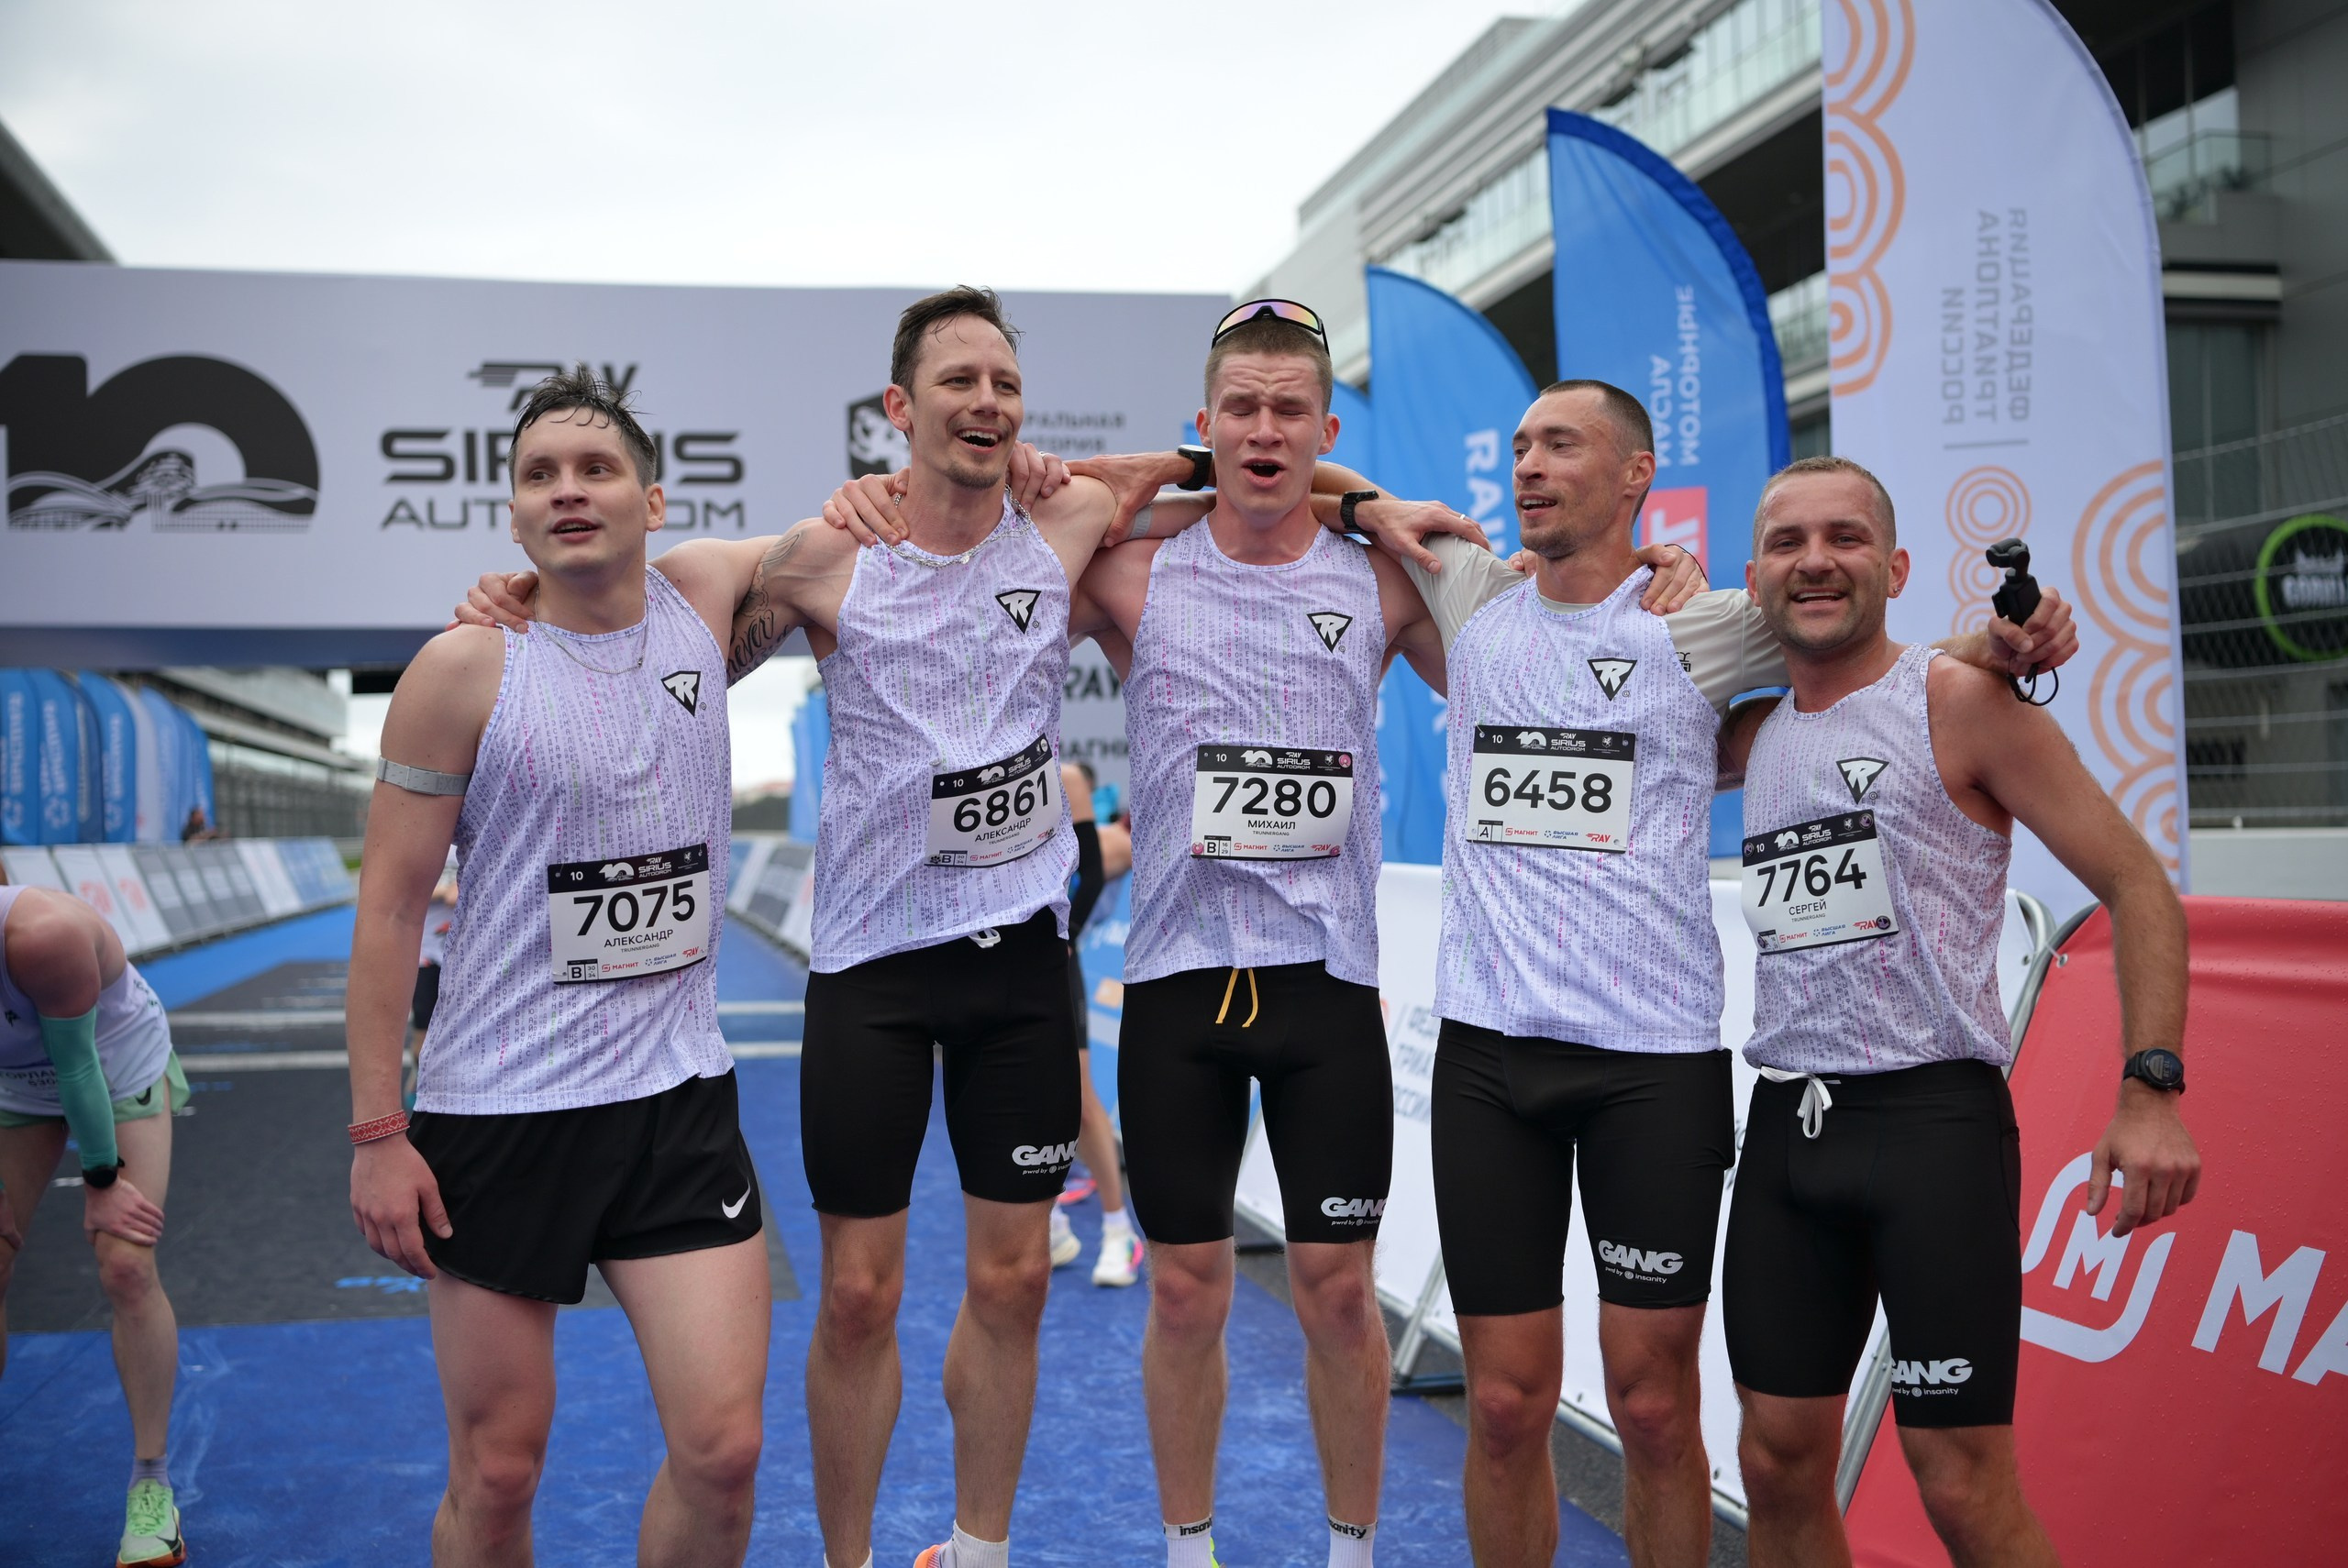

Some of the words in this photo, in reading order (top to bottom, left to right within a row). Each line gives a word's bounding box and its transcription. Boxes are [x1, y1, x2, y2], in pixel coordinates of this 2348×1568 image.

[1492, 734, 1502, 744] 10
[1216, 754, 1227, 762] 10
[1277, 757, 1311, 766] SIRIUS
[1008, 757, 1031, 773] SIRIUS
[952, 778, 964, 788] 10
[1484, 767, 1612, 813] 6458
[953, 770, 1048, 833] 6861
[1213, 777, 1336, 818] 7280
[974, 818, 1032, 842] АЛЕКСАНДР
[1247, 820, 1296, 830] МИХАИЛ
[1801, 829, 1832, 842] SIRIUS
[1756, 843, 1765, 853] 10
[980, 851, 1002, 860] МАГНИТ
[638, 862, 671, 873] SIRIUS
[570, 871, 583, 881] 10
[638, 868, 671, 878] AUTODROM
[1757, 848, 1867, 908] 7764
[573, 879, 695, 936] 7075
[1789, 899, 1827, 915] СЕРГЕЙ
[604, 929, 674, 948] АЛЕКСАНДР
[1787, 932, 1808, 941] МАГНИТ
[621, 944, 660, 954] TRUNNERGANG
[612, 962, 639, 970] МАГНИТ
[1598, 1240, 1684, 1275] GANG
[1616, 1268, 1623, 1276] by
[1634, 1273, 1667, 1284] insanity
[1902, 1387, 1911, 1396] by
